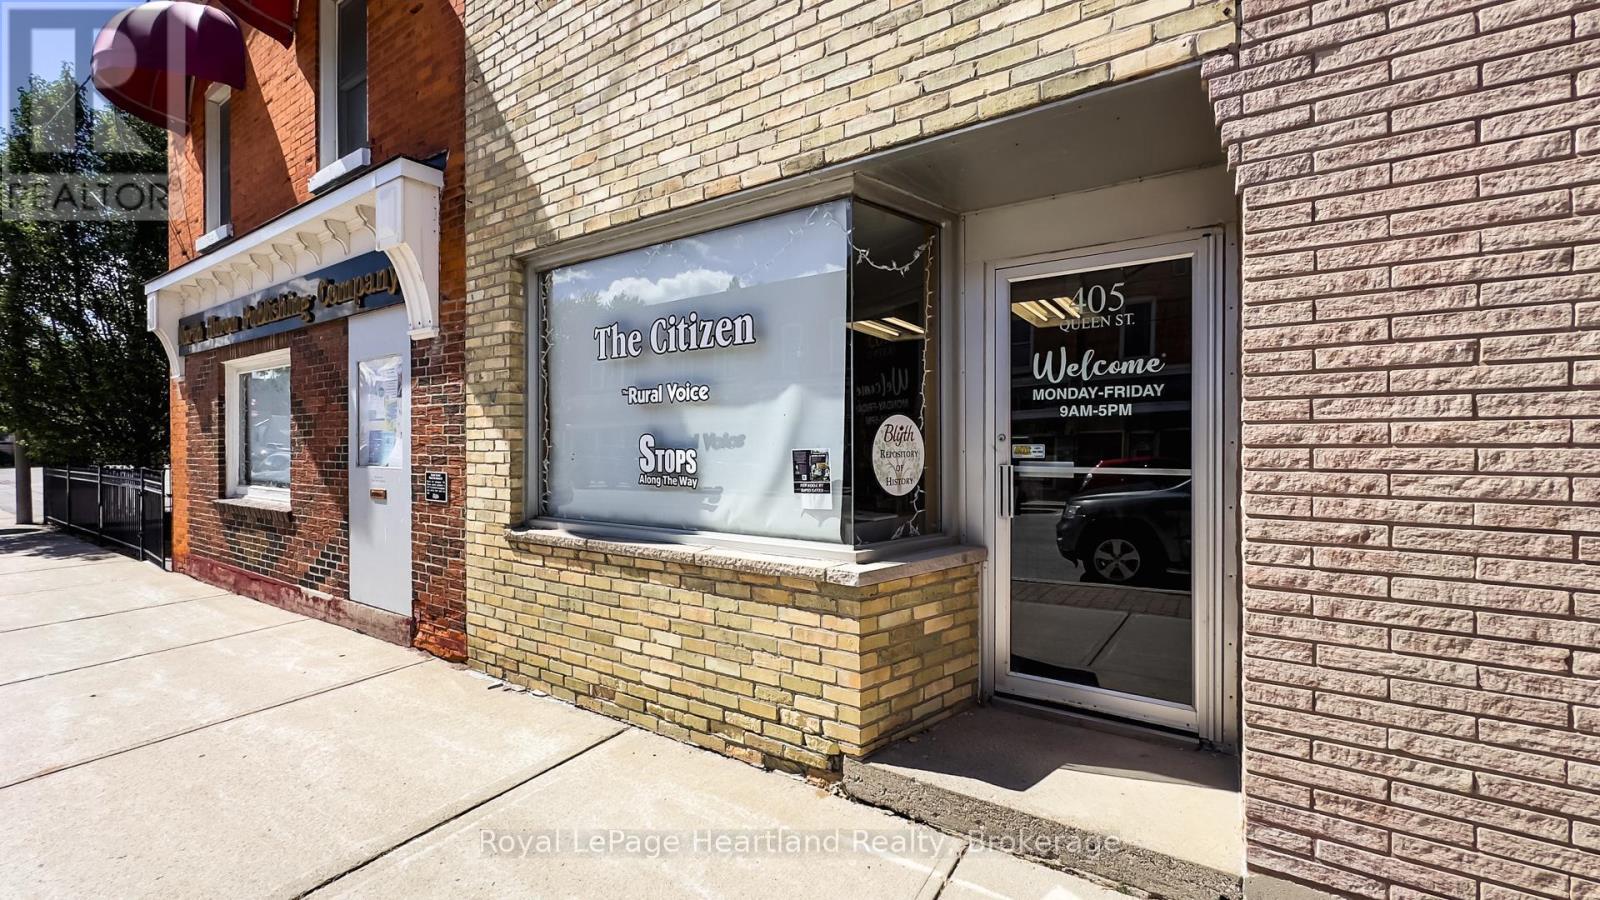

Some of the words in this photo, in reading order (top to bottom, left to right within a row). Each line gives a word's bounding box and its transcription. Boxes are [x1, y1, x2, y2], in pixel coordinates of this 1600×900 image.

[318, 266, 399, 307] Company
[1070, 282, 1125, 314] 405
[1059, 315, 1111, 332] QUEEN
[1115, 313, 1136, 326] ST.
[594, 322, 642, 361] The
[650, 311, 756, 354] Citizen
[1033, 346, 1166, 384] Welcome
[628, 385, 663, 404] Rural
[666, 381, 710, 404] Voice
[1032, 384, 1165, 400] MONDAY-FRIDAY
[1059, 404, 1132, 417] 9AM-5PM
[884, 424, 914, 446] Blyth
[639, 433, 697, 474] STOPS
[880, 450, 918, 459] REPOSITORY
[639, 474, 661, 487] Along
[662, 475, 678, 486] The
[679, 475, 698, 489] Way
[886, 477, 913, 487] HISTORY
